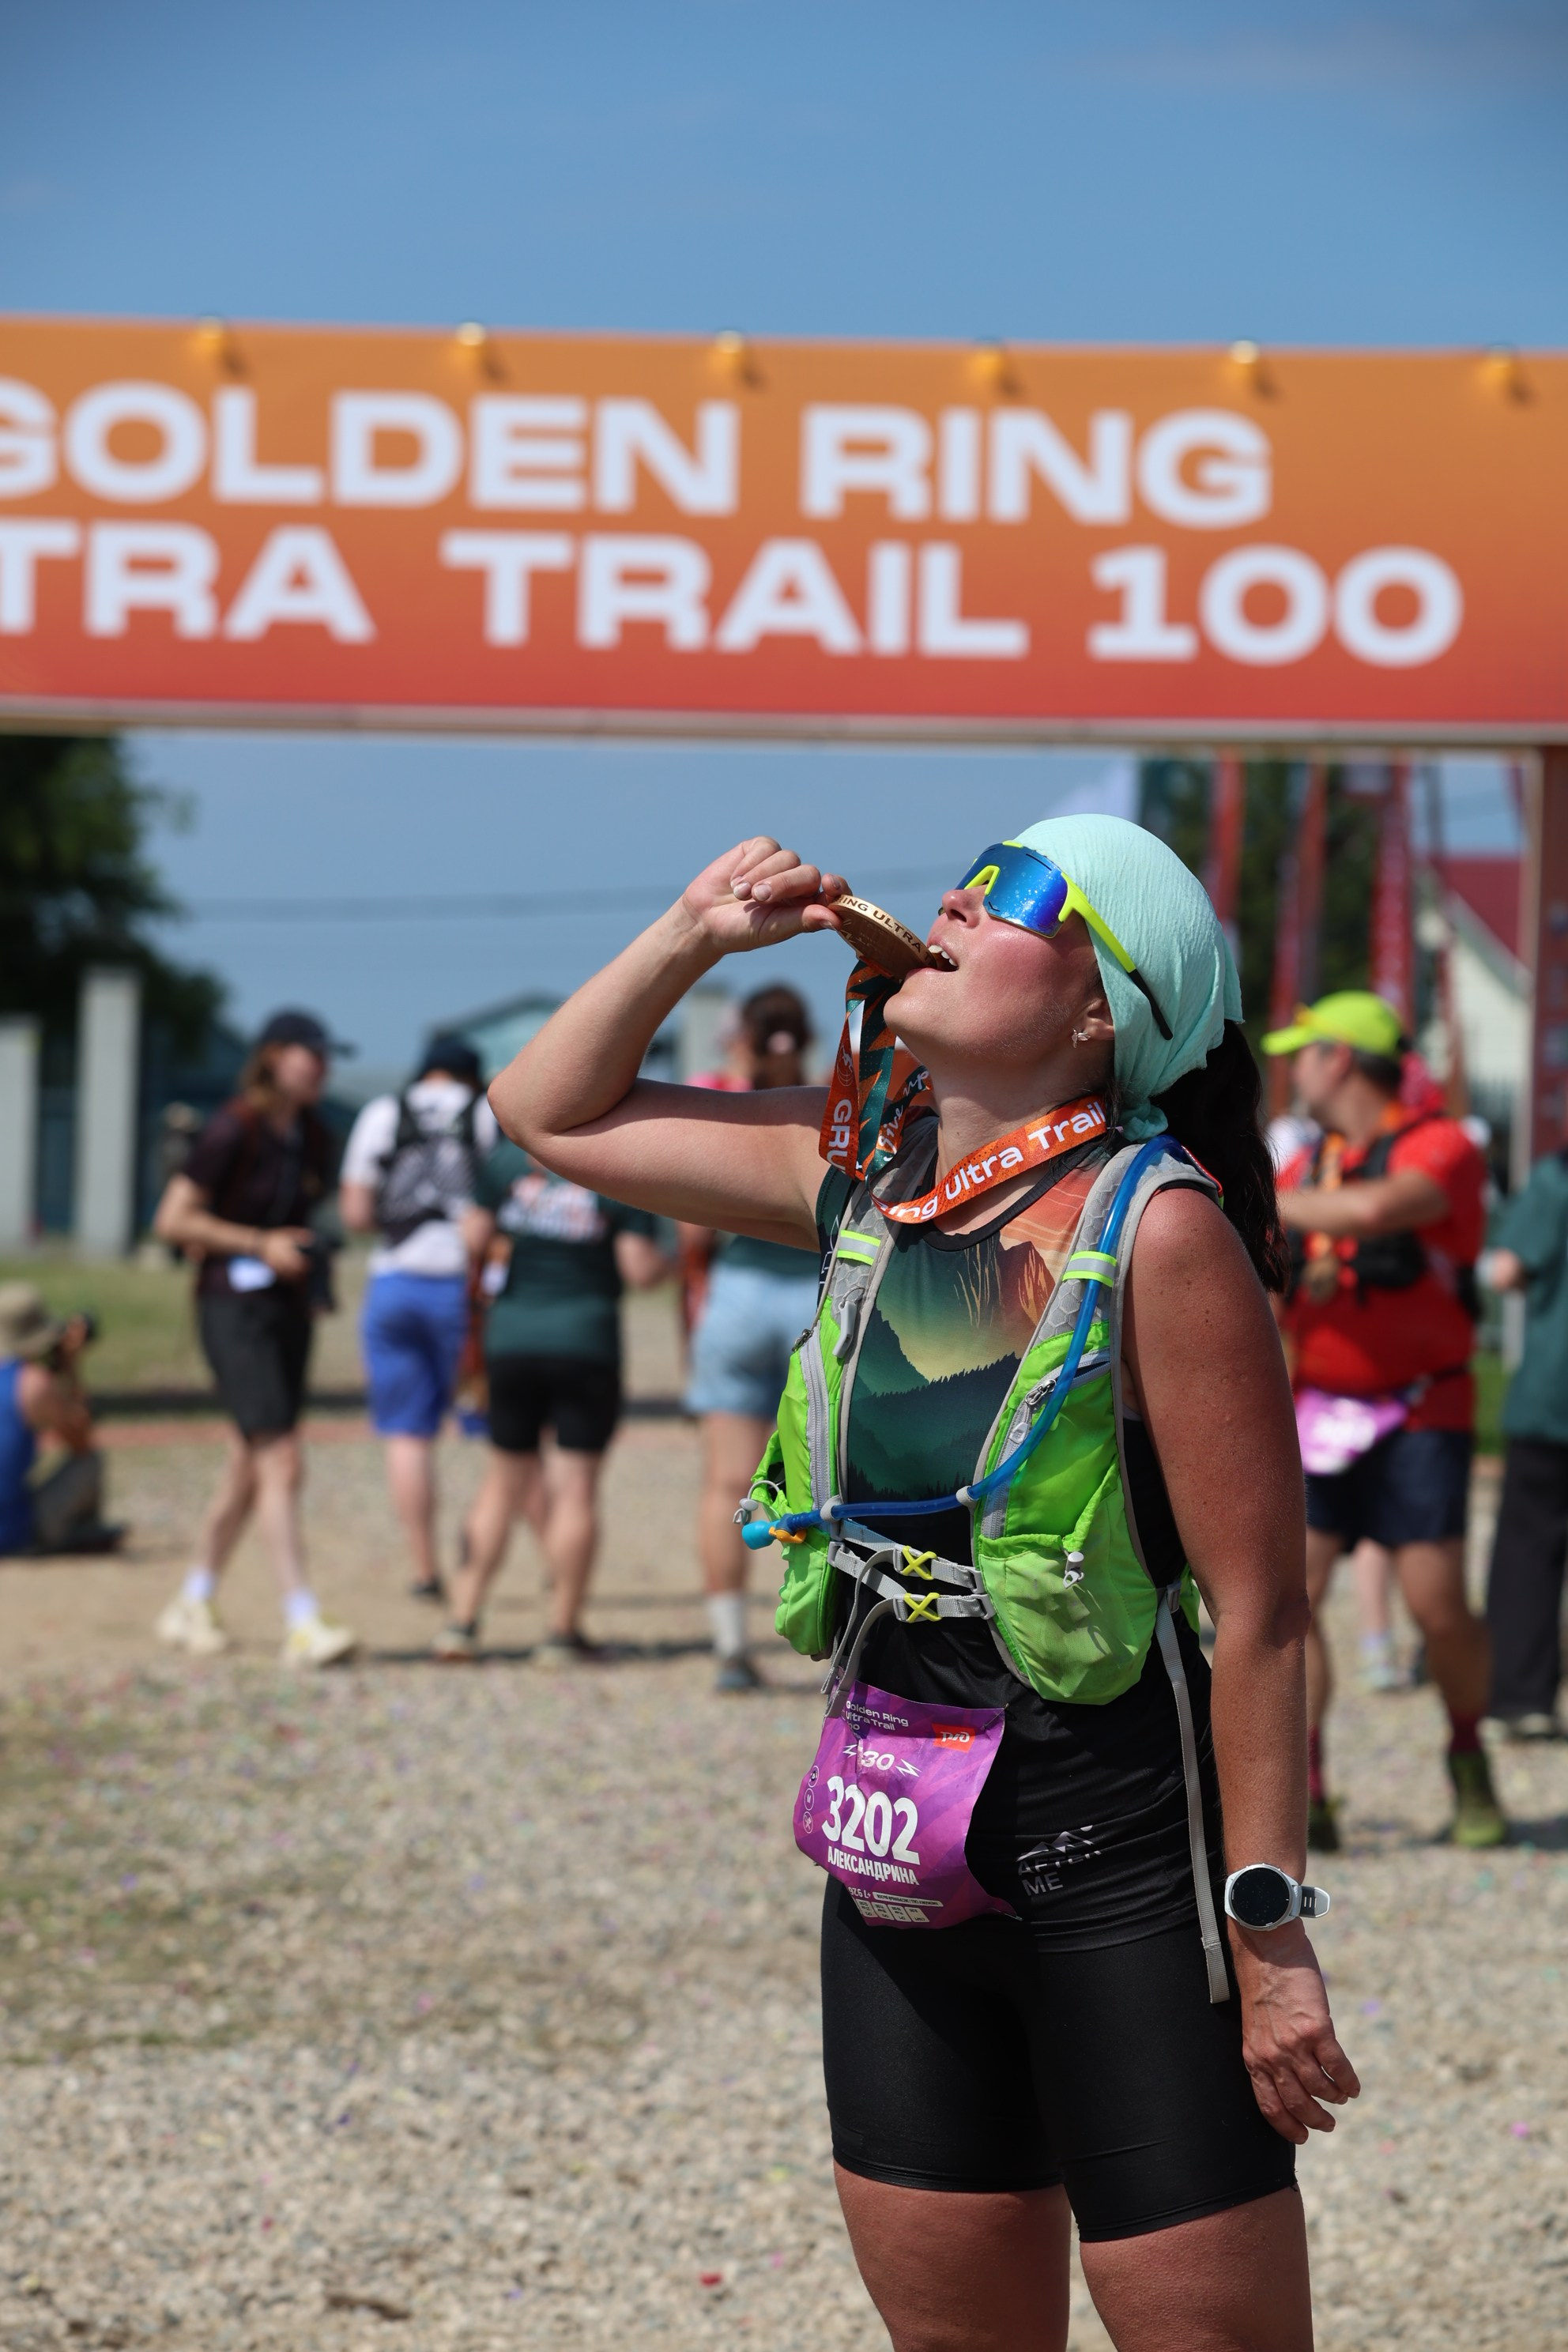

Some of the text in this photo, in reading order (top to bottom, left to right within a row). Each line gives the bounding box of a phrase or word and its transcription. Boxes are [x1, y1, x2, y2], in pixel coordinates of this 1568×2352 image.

[800, 403, 1273, 530] RING
[439, 527, 1028, 660] TRAIL
[1087, 543, 1464, 669] 100
[839, 895, 922, 954] ING ULTRA
[945, 1146, 1024, 1200] Ultra
[1028, 1101, 1106, 1150] Trail
[846, 1700, 909, 1727] Golden Ring
[846, 1710, 895, 1731] Ultra Trail
[861, 1751, 895, 1770] 30
[821, 1775, 921, 1865] 3202
[827, 1845, 920, 1885] АЛЕКСАНДРИНА
[1022, 1871, 1064, 1896] ME
